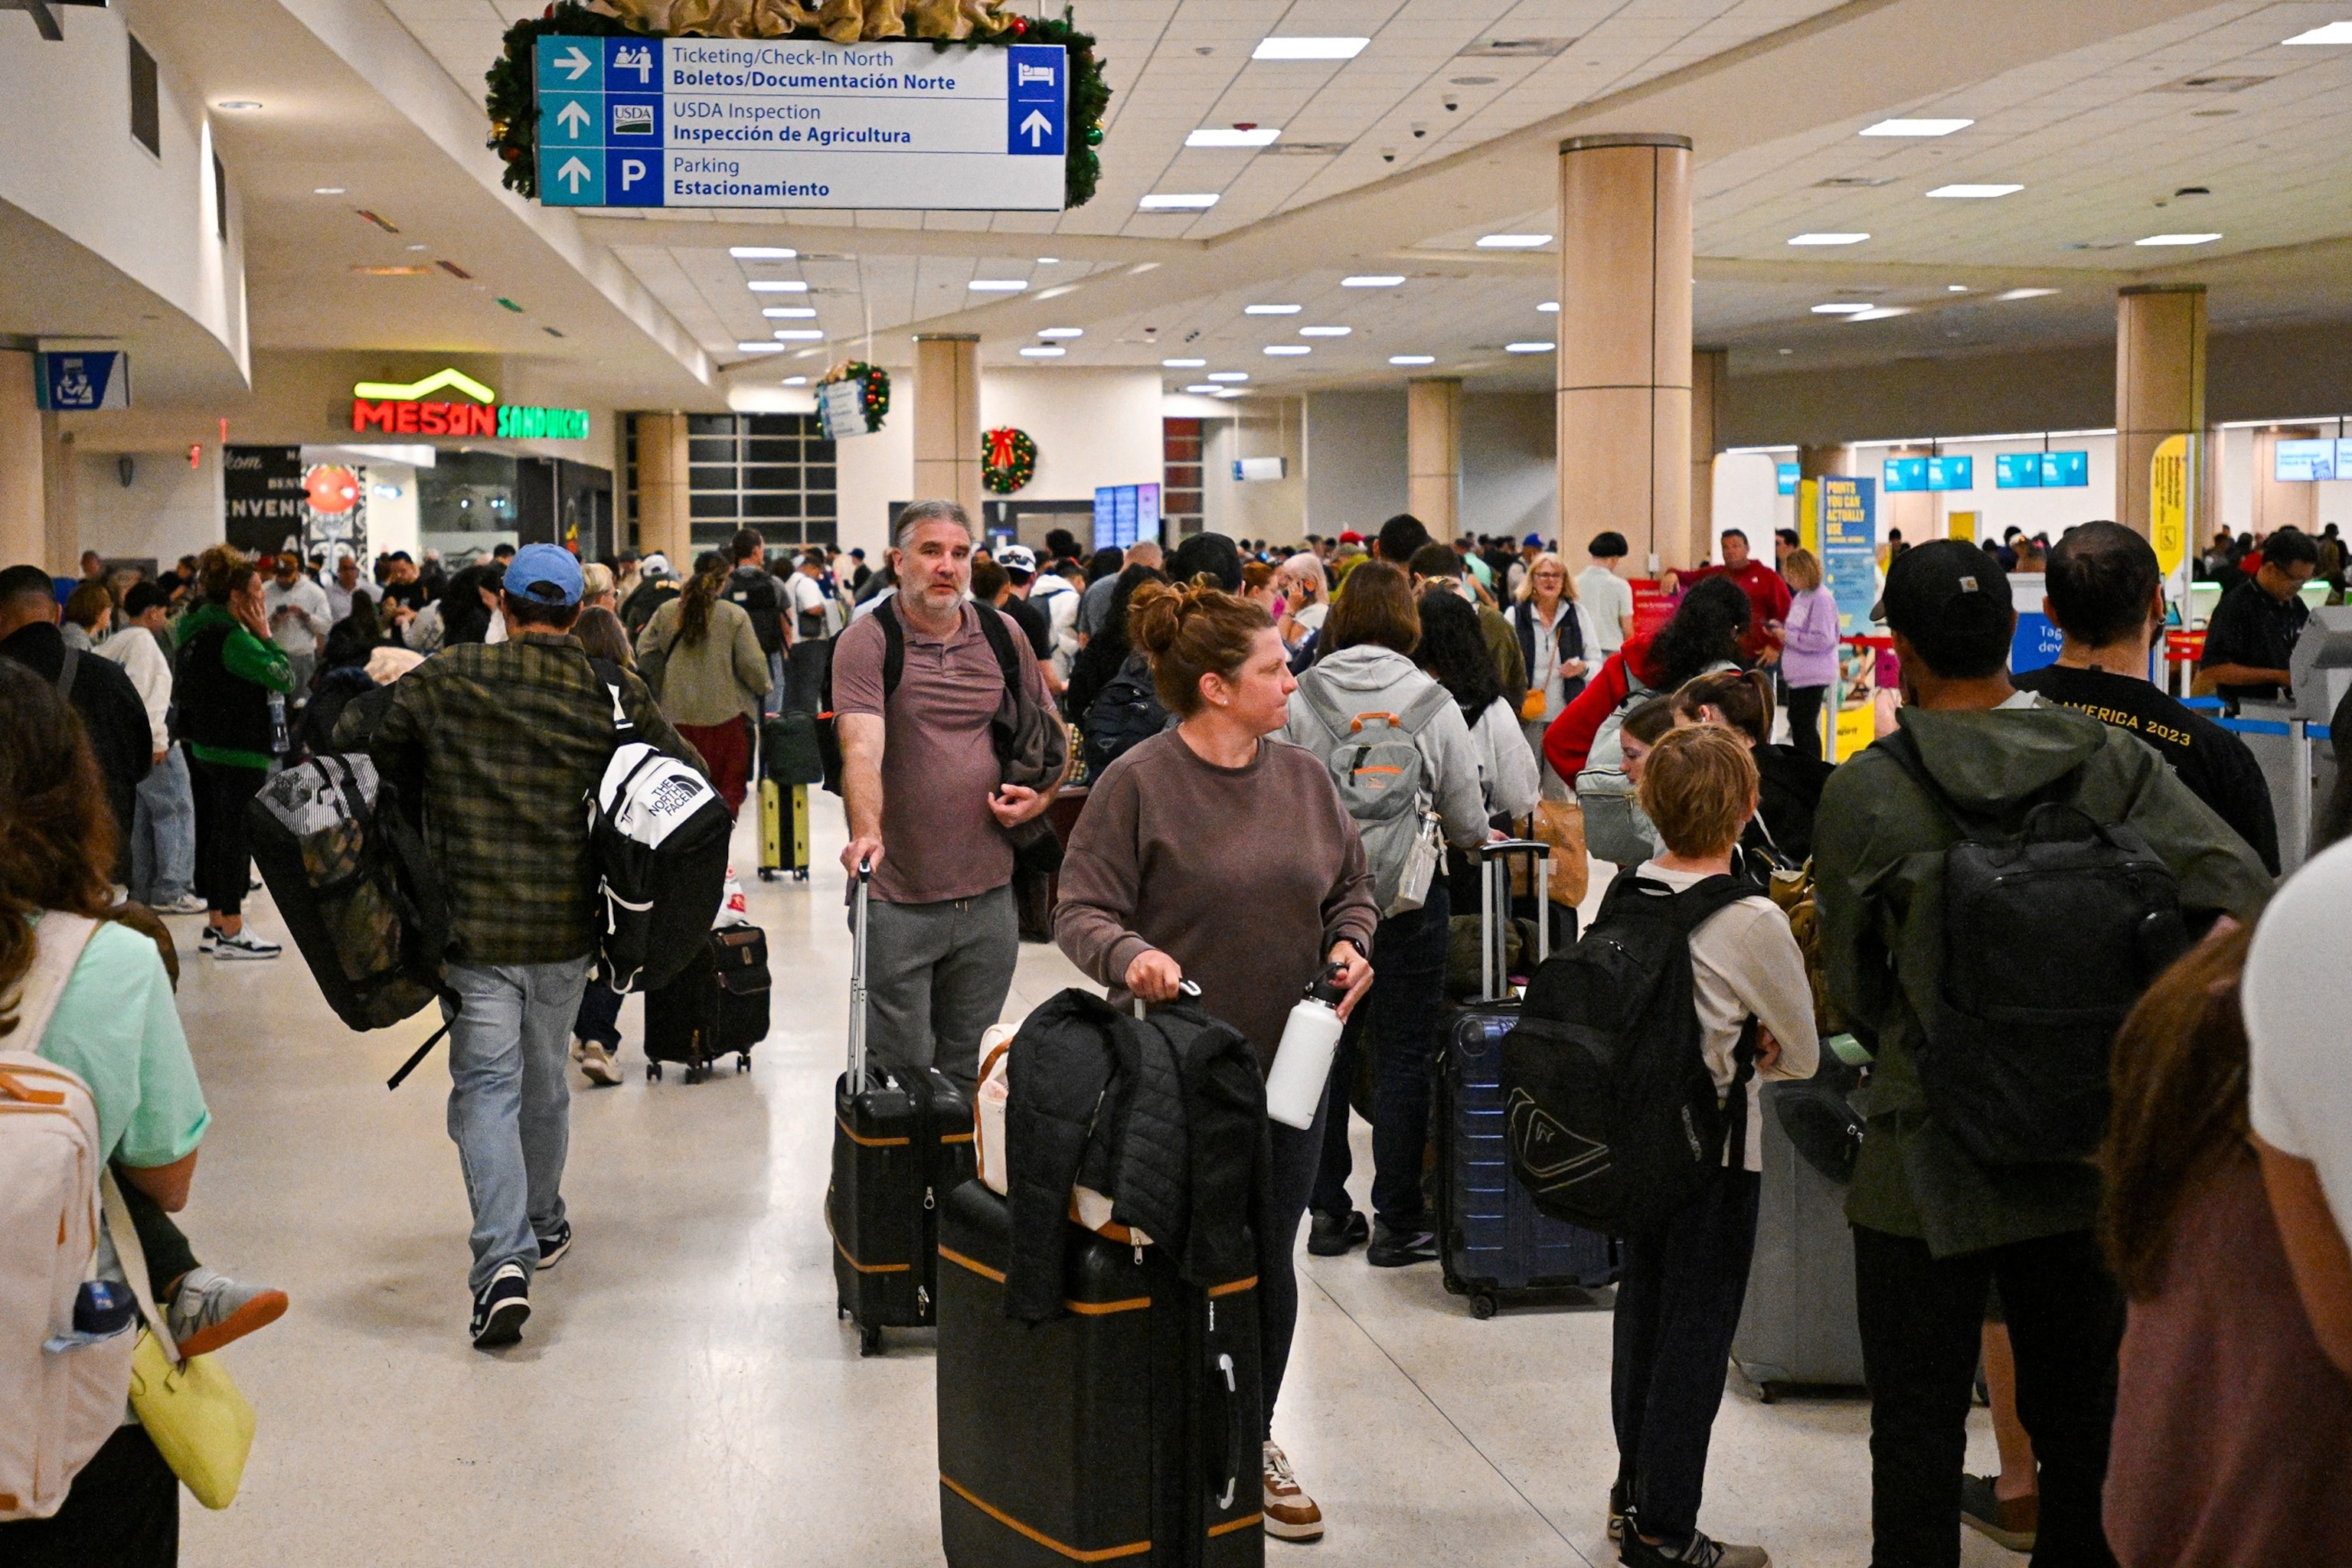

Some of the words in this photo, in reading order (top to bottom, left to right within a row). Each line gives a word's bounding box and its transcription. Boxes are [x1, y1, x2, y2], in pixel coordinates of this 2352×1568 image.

[672, 47, 838, 68] Ticketing/Check-In
[844, 51, 893, 67] North
[674, 70, 898, 90] Boletos/Documentación
[903, 74, 956, 90] Norte
[615, 106, 652, 119] USDA
[674, 102, 724, 118] USDA
[729, 103, 821, 122] Inspection
[674, 125, 773, 144] Inspección
[779, 126, 802, 142] de
[807, 126, 911, 146] Agricultura
[674, 157, 740, 177] Parking
[674, 180, 830, 197] Estacionamiento
[2040, 626, 2063, 641] Tag
[2038, 641, 2062, 653] dev
[2145, 720, 2191, 746] 2023
[651, 779, 673, 796] THE
[648, 785, 682, 816] NORTH
[664, 792, 690, 816] FACE
